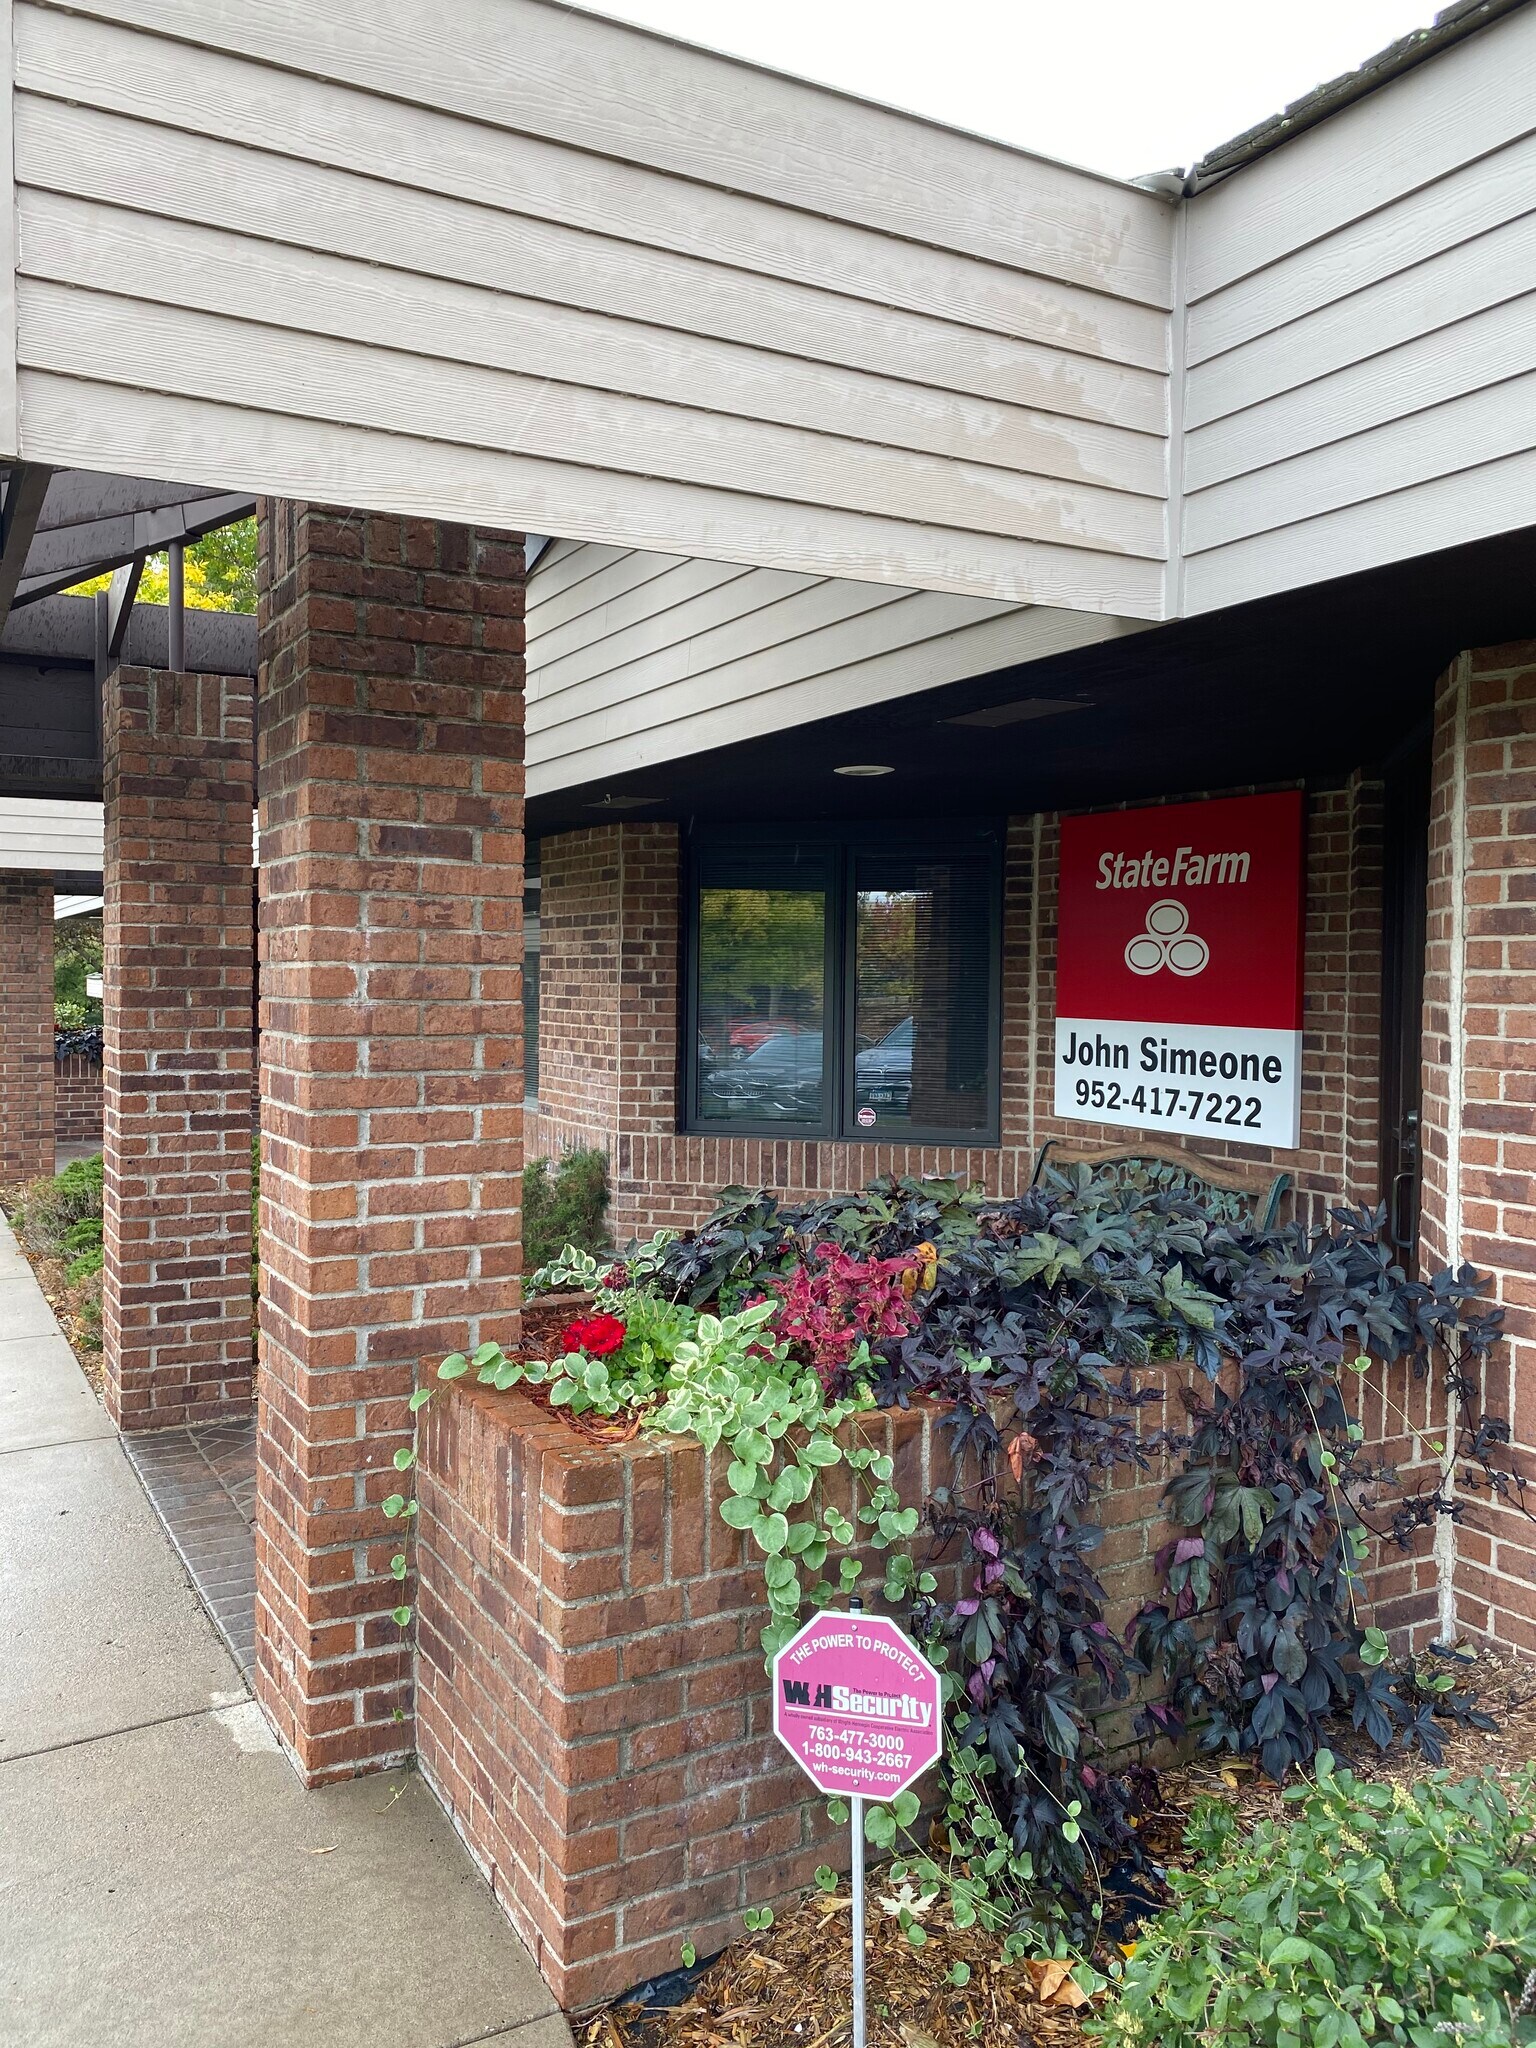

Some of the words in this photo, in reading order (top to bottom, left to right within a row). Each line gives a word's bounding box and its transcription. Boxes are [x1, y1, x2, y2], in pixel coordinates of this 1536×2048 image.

[1062, 1032, 1129, 1069] John
[1140, 1036, 1283, 1084] Simeone
[1075, 1078, 1263, 1129] 952-417-7222
[789, 1644, 814, 1665] THE
[811, 1634, 854, 1652] POWER
[855, 1635, 872, 1650] TO
[873, 1639, 926, 1683] PROTECT
[801, 1740, 912, 1769] 1-800-943-2667
[808, 1725, 904, 1751] 763-477-3000
[812, 1761, 901, 1783] wh-security.com
